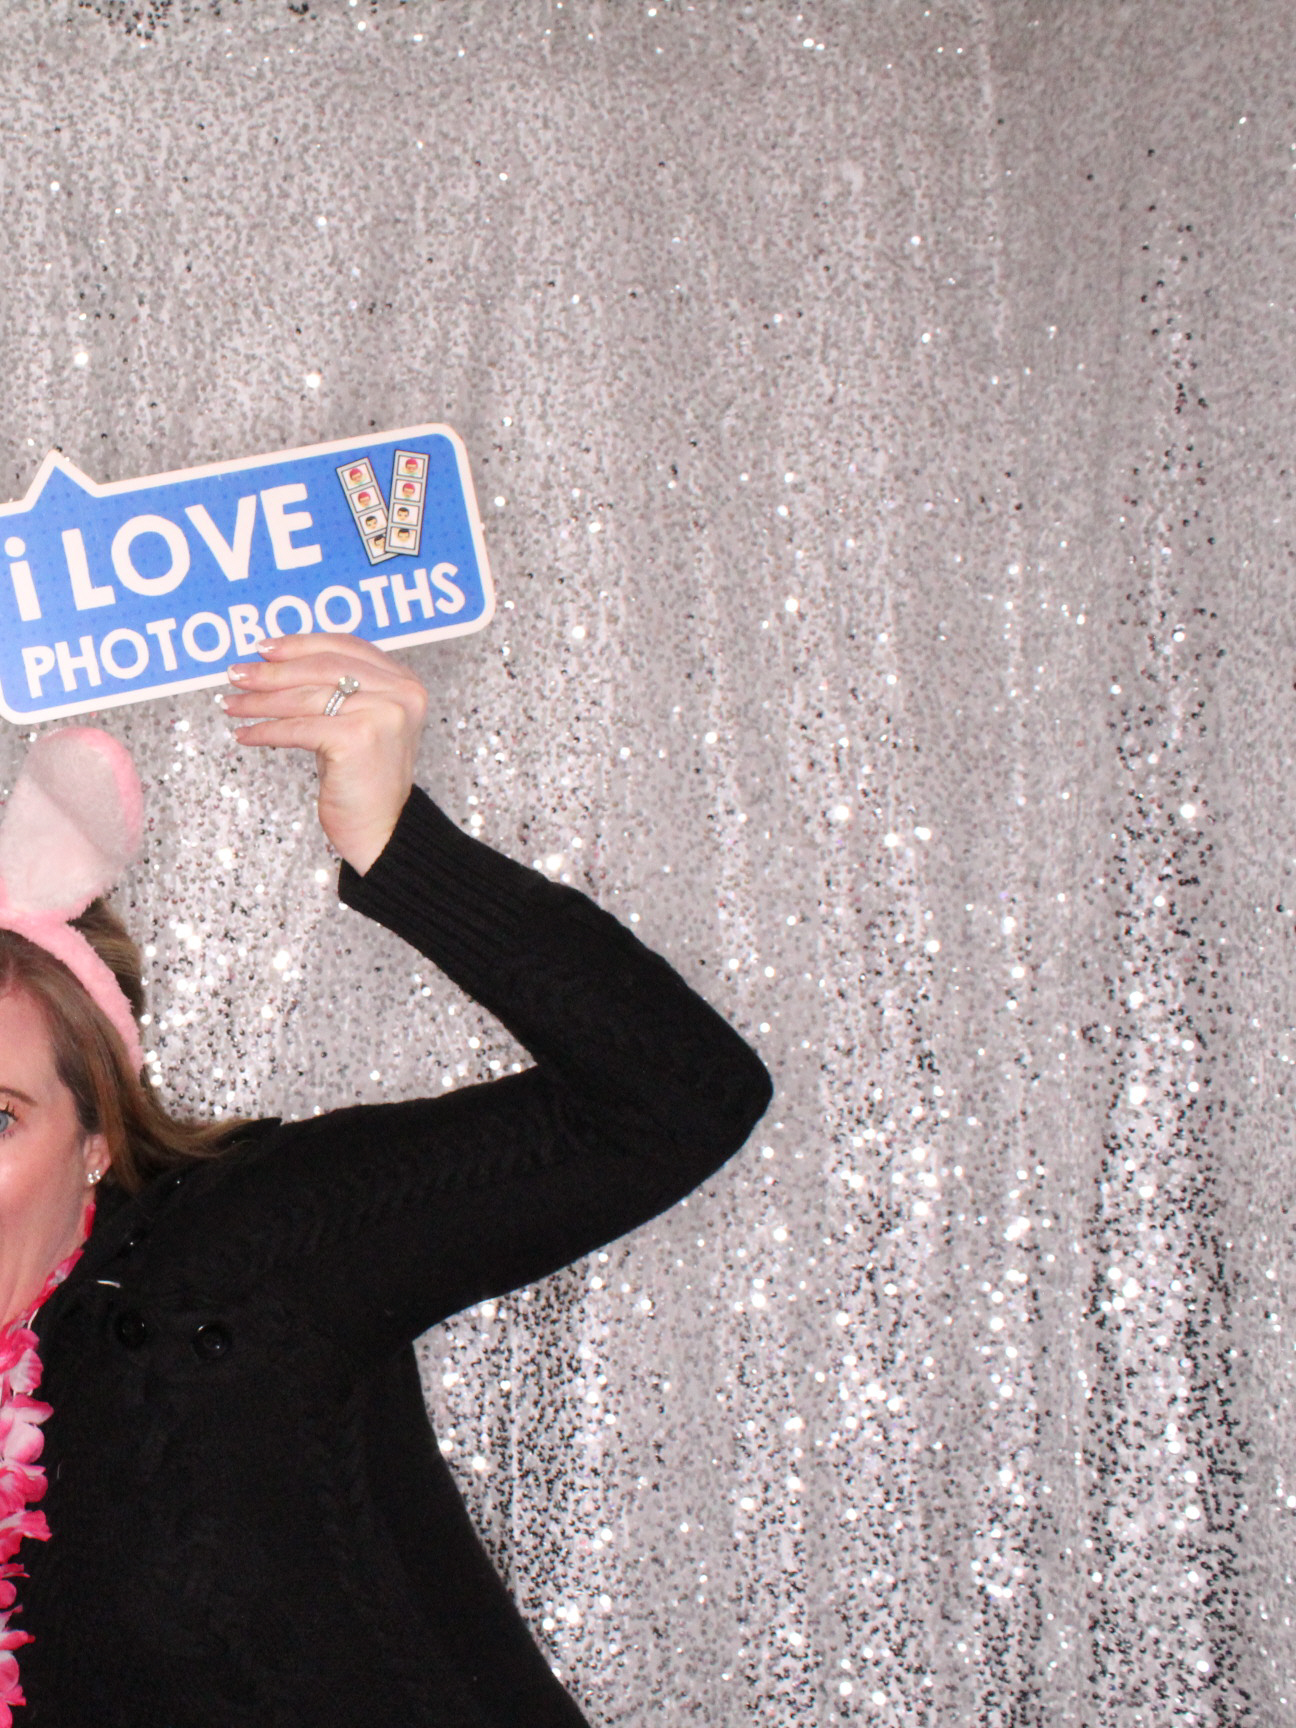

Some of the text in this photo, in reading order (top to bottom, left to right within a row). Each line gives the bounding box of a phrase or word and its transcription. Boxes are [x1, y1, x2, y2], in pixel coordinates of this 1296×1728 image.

[3, 482, 323, 622] i LOVE
[21, 562, 466, 699] PHOTOBOOTHS
